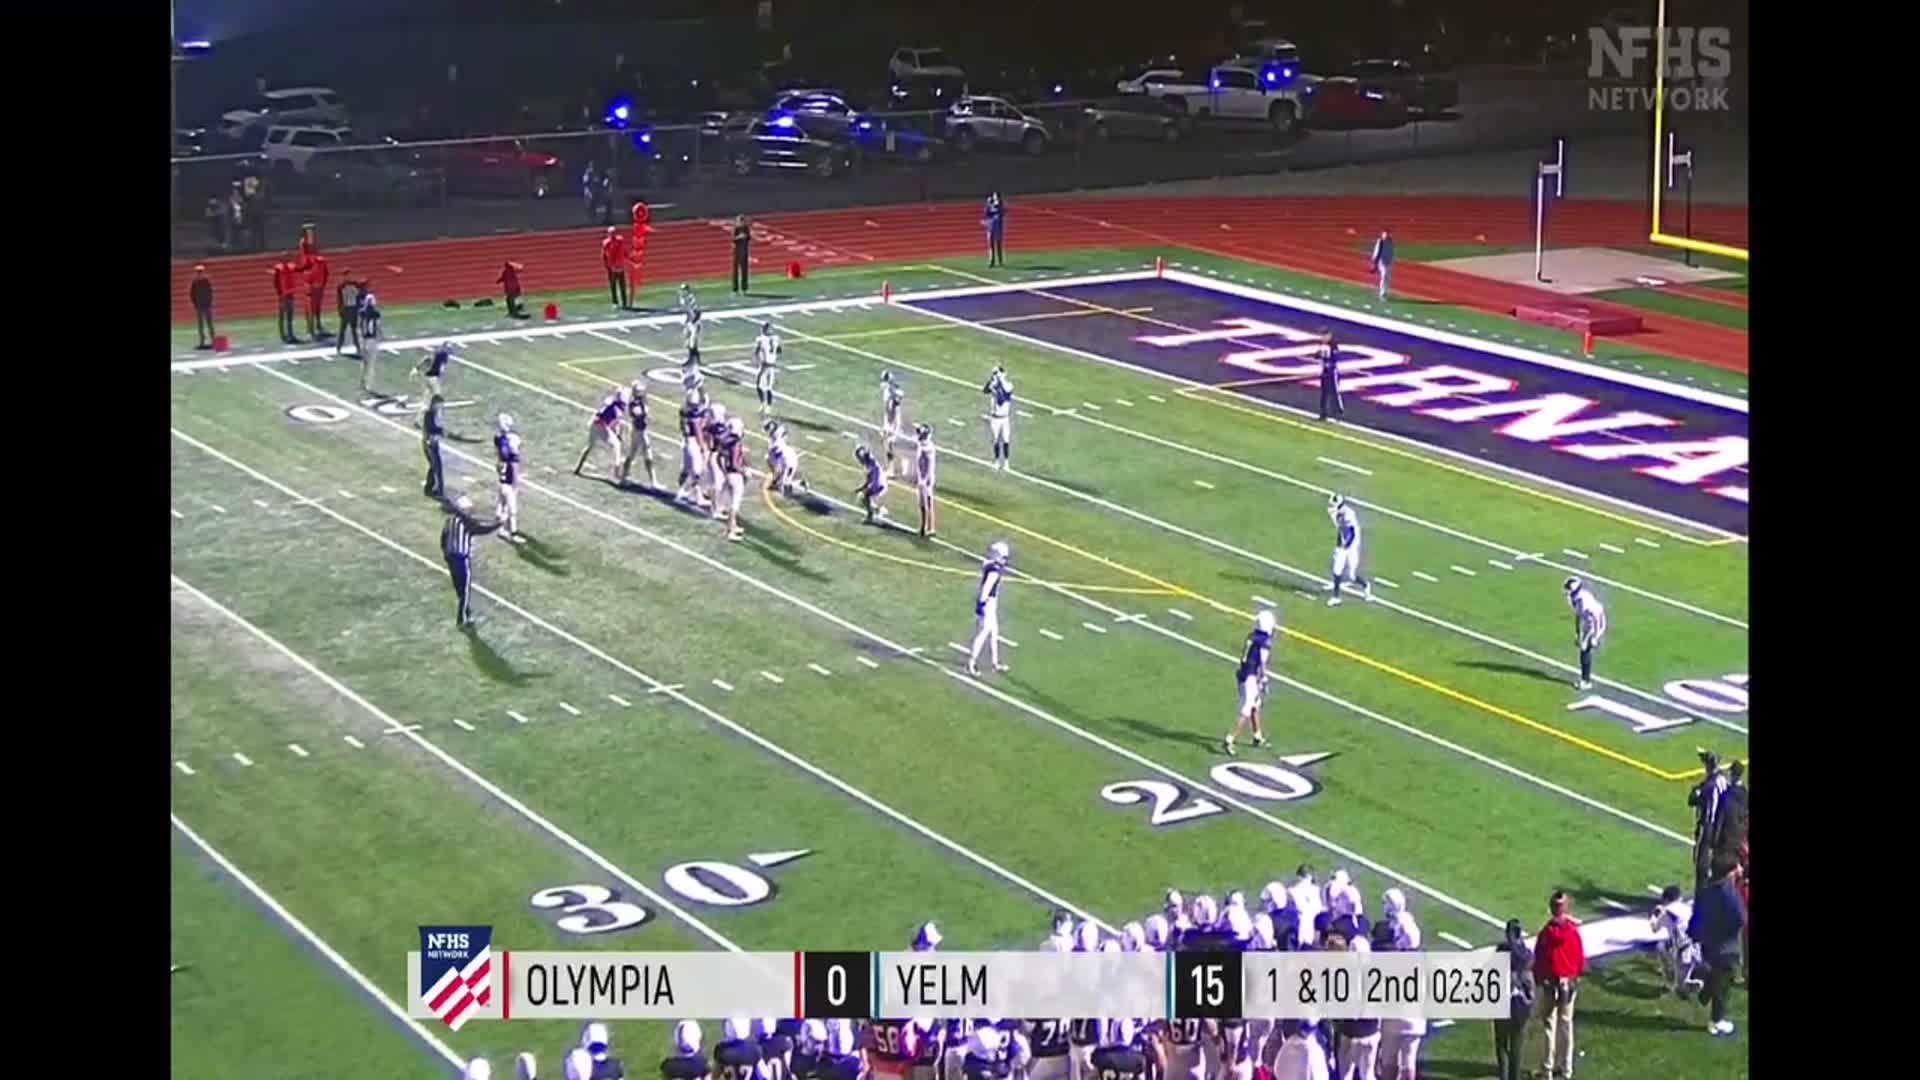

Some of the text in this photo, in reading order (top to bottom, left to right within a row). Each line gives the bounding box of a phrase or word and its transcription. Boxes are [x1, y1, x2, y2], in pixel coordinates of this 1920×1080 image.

[1130, 317, 1750, 502] TORNA
[1566, 679, 1749, 733] 10
[1101, 761, 1315, 826] 20
[530, 861, 772, 934] 30
